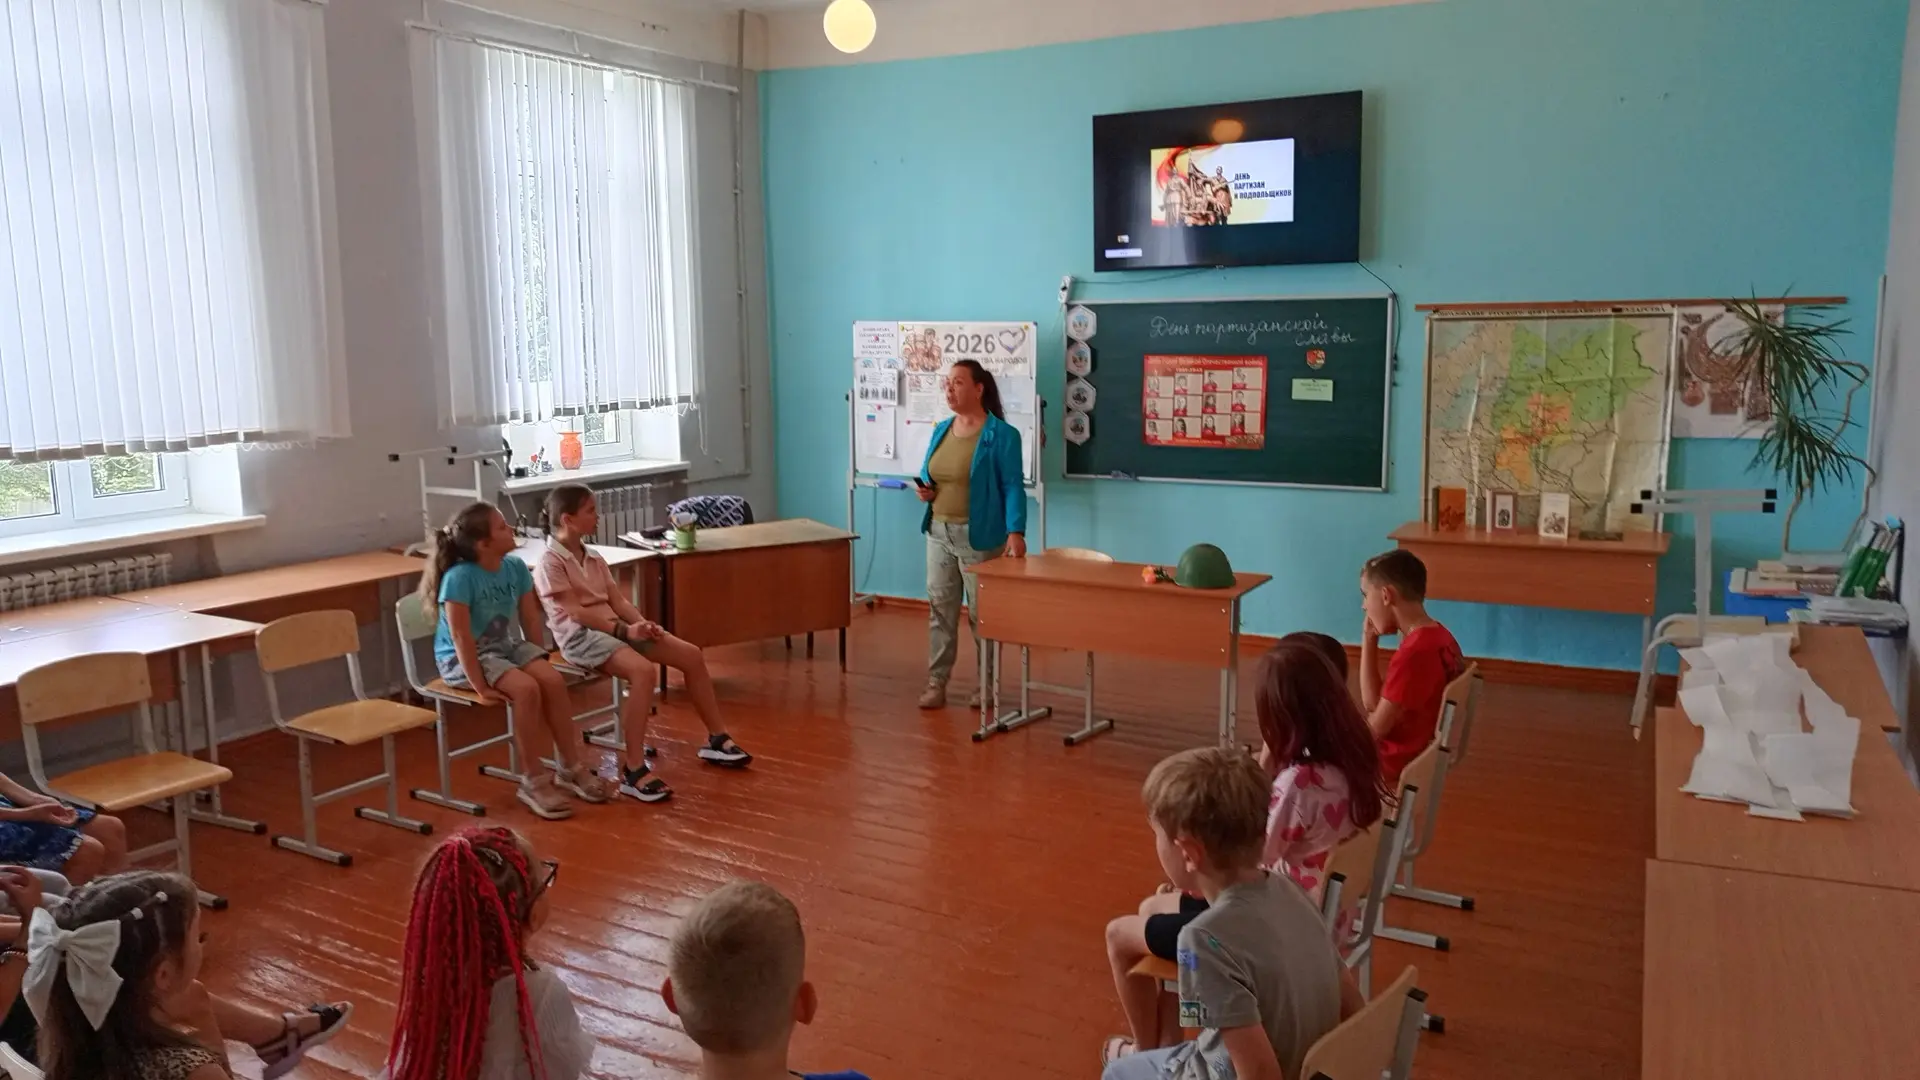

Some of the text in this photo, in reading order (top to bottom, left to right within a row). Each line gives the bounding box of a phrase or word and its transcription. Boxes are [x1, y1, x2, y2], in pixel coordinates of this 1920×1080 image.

[1234, 172, 1251, 181] ДЕНЬ
[1234, 181, 1266, 190] ПАРТИЗАН
[1239, 189, 1292, 199] ПОДПОЛЬЩИКОВ
[1150, 312, 1328, 345] День партизанской
[944, 333, 995, 354] 2026
